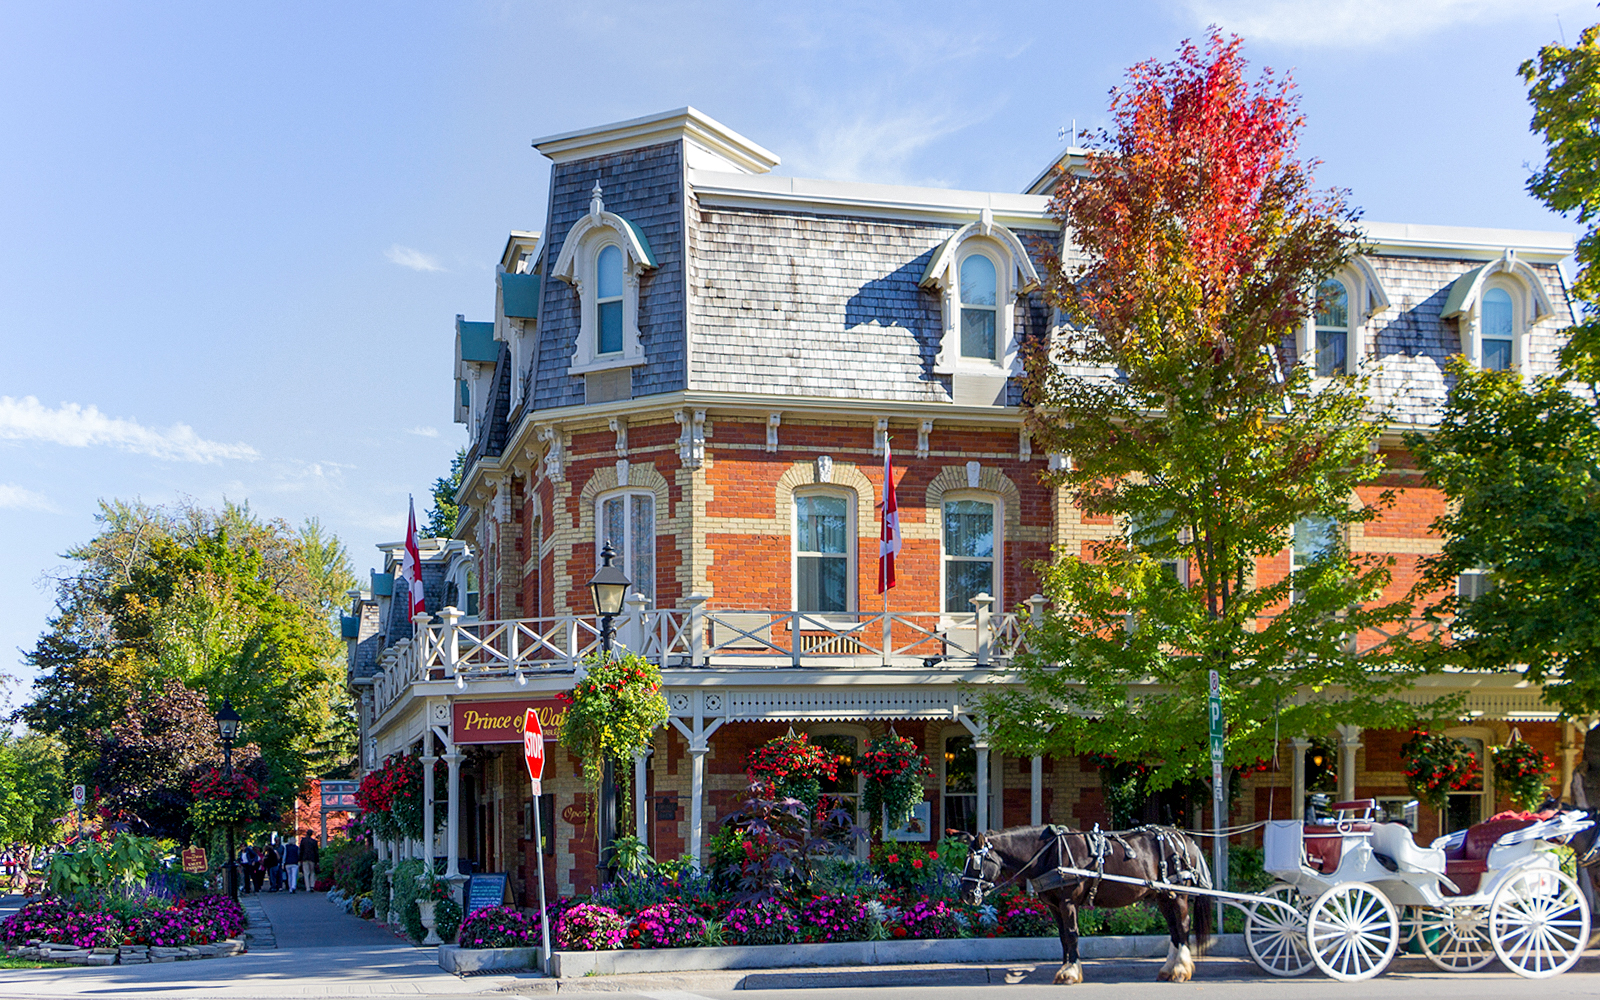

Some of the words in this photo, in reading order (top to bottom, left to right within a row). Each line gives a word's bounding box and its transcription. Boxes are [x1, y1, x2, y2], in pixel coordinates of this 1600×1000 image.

[464, 710, 512, 730] Prince
[535, 707, 568, 727] Wal
[1212, 702, 1220, 730] P
[525, 731, 543, 759] STOP
